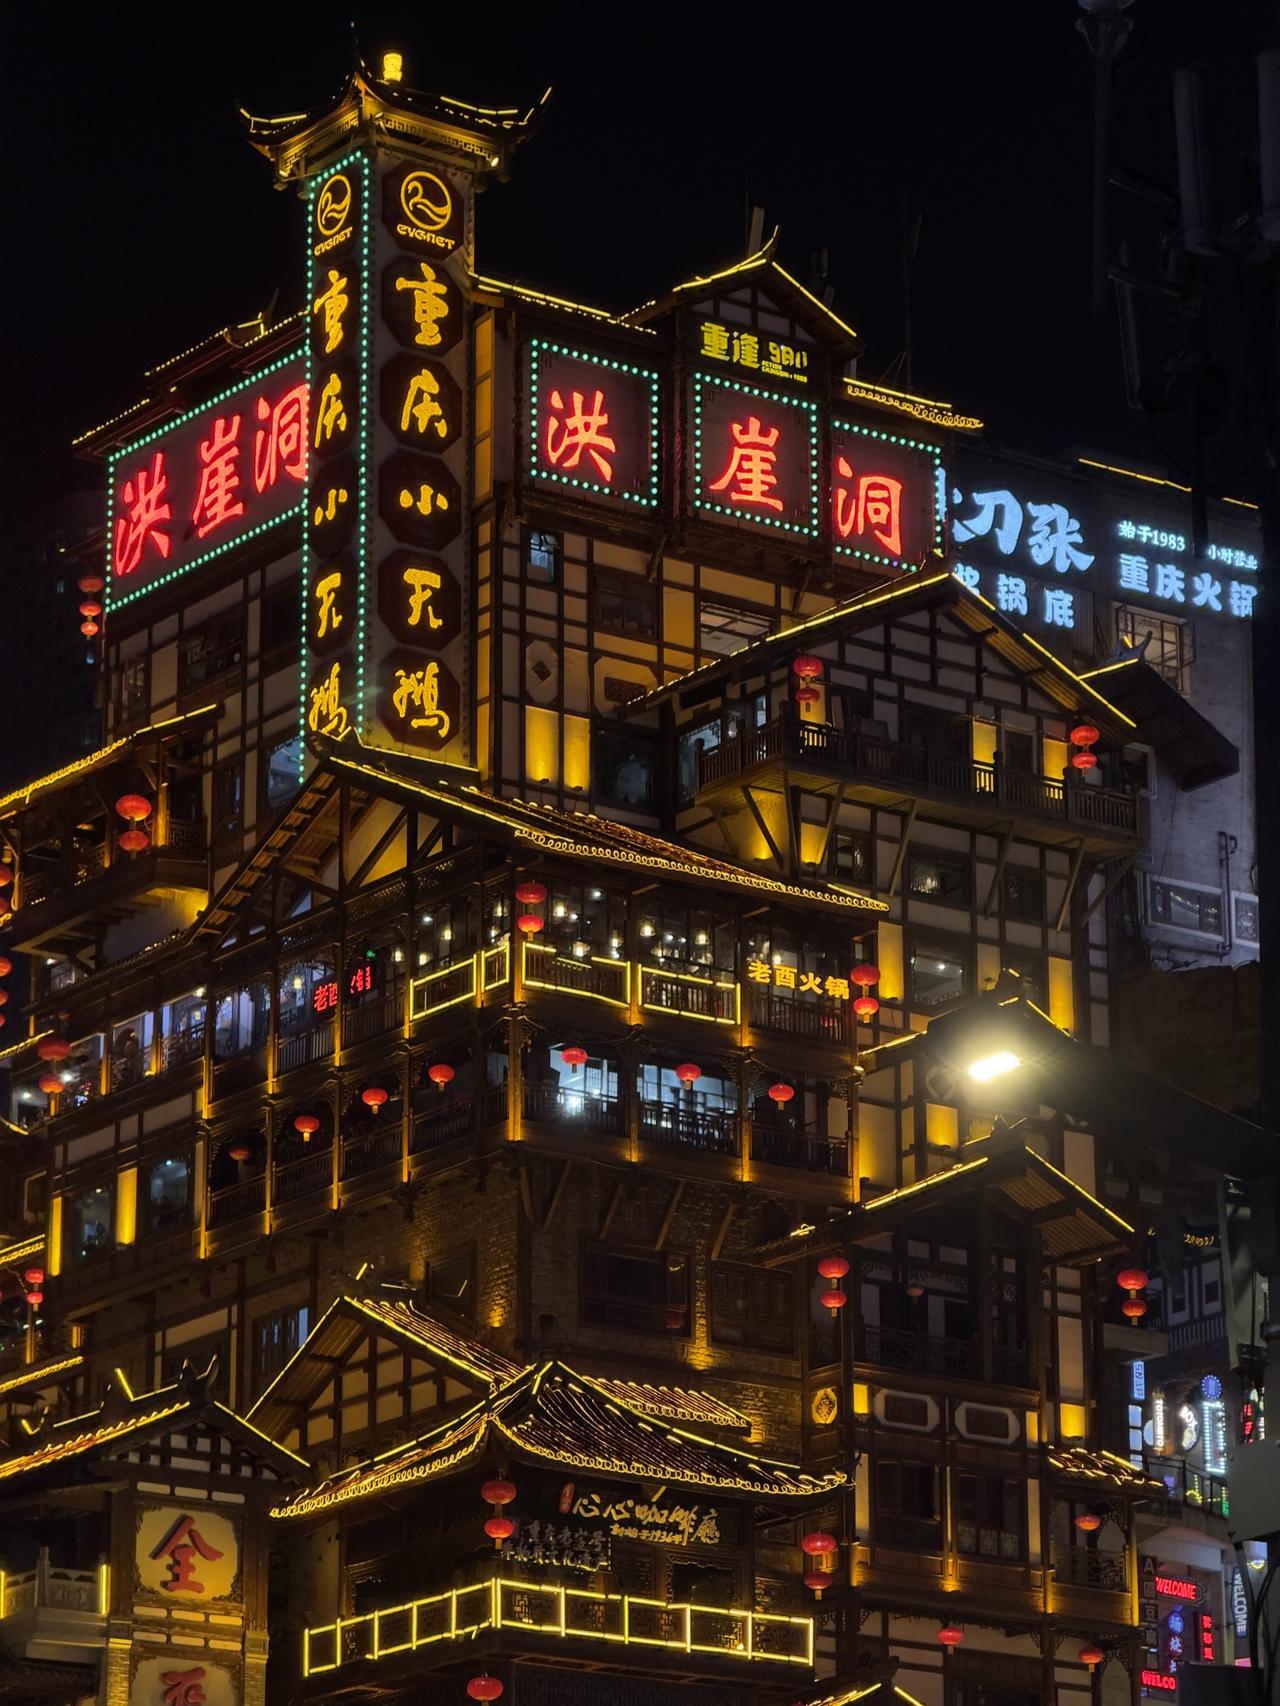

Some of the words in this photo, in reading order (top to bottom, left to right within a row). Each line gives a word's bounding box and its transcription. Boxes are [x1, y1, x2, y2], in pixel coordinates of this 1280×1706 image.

[114, 383, 309, 577] 洪崖洞
[393, 262, 449, 738] 重庆小天鹅
[547, 389, 903, 556] 洪崖洞
[1118, 520, 1187, 552] 始于1983
[1119, 553, 1258, 618] 重庆火锅
[1155, 1576, 1197, 1600] WELCOME
[1233, 1572, 1247, 1633] WELCOME
